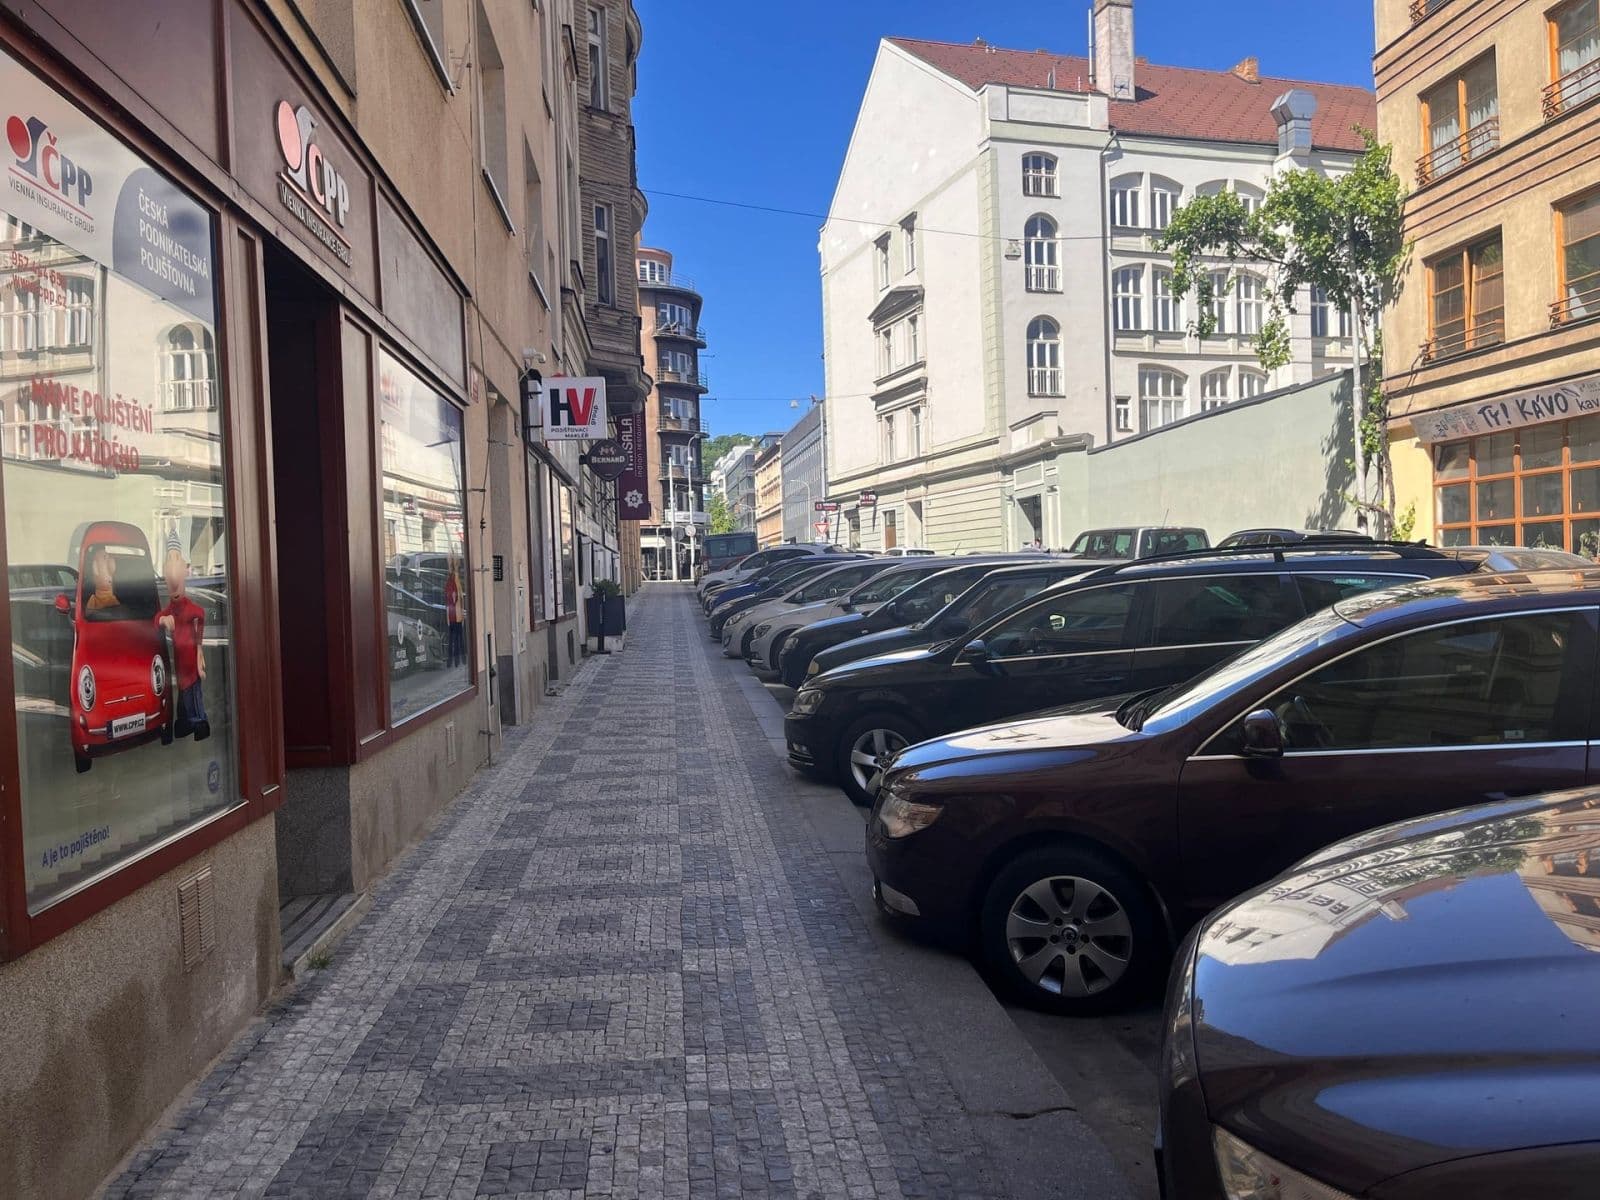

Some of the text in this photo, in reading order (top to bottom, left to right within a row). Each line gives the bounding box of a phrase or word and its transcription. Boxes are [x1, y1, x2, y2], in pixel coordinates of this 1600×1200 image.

[41, 131, 93, 207] ČPP
[8, 175, 95, 234] VIENNA INSURANCE GROUP
[138, 188, 169, 228] ČESKÁ
[139, 218, 209, 279] PODNIKATELSKÁ
[140, 247, 196, 296] POJIŠŤOVNA
[82, 391, 153, 434] POJIŠTĚNÍ
[550, 388, 596, 426] HV
[1477, 402, 1511, 428] TY!
[34, 424, 67, 459] PRO
[41, 825, 110, 868] A je to pojištěno!
